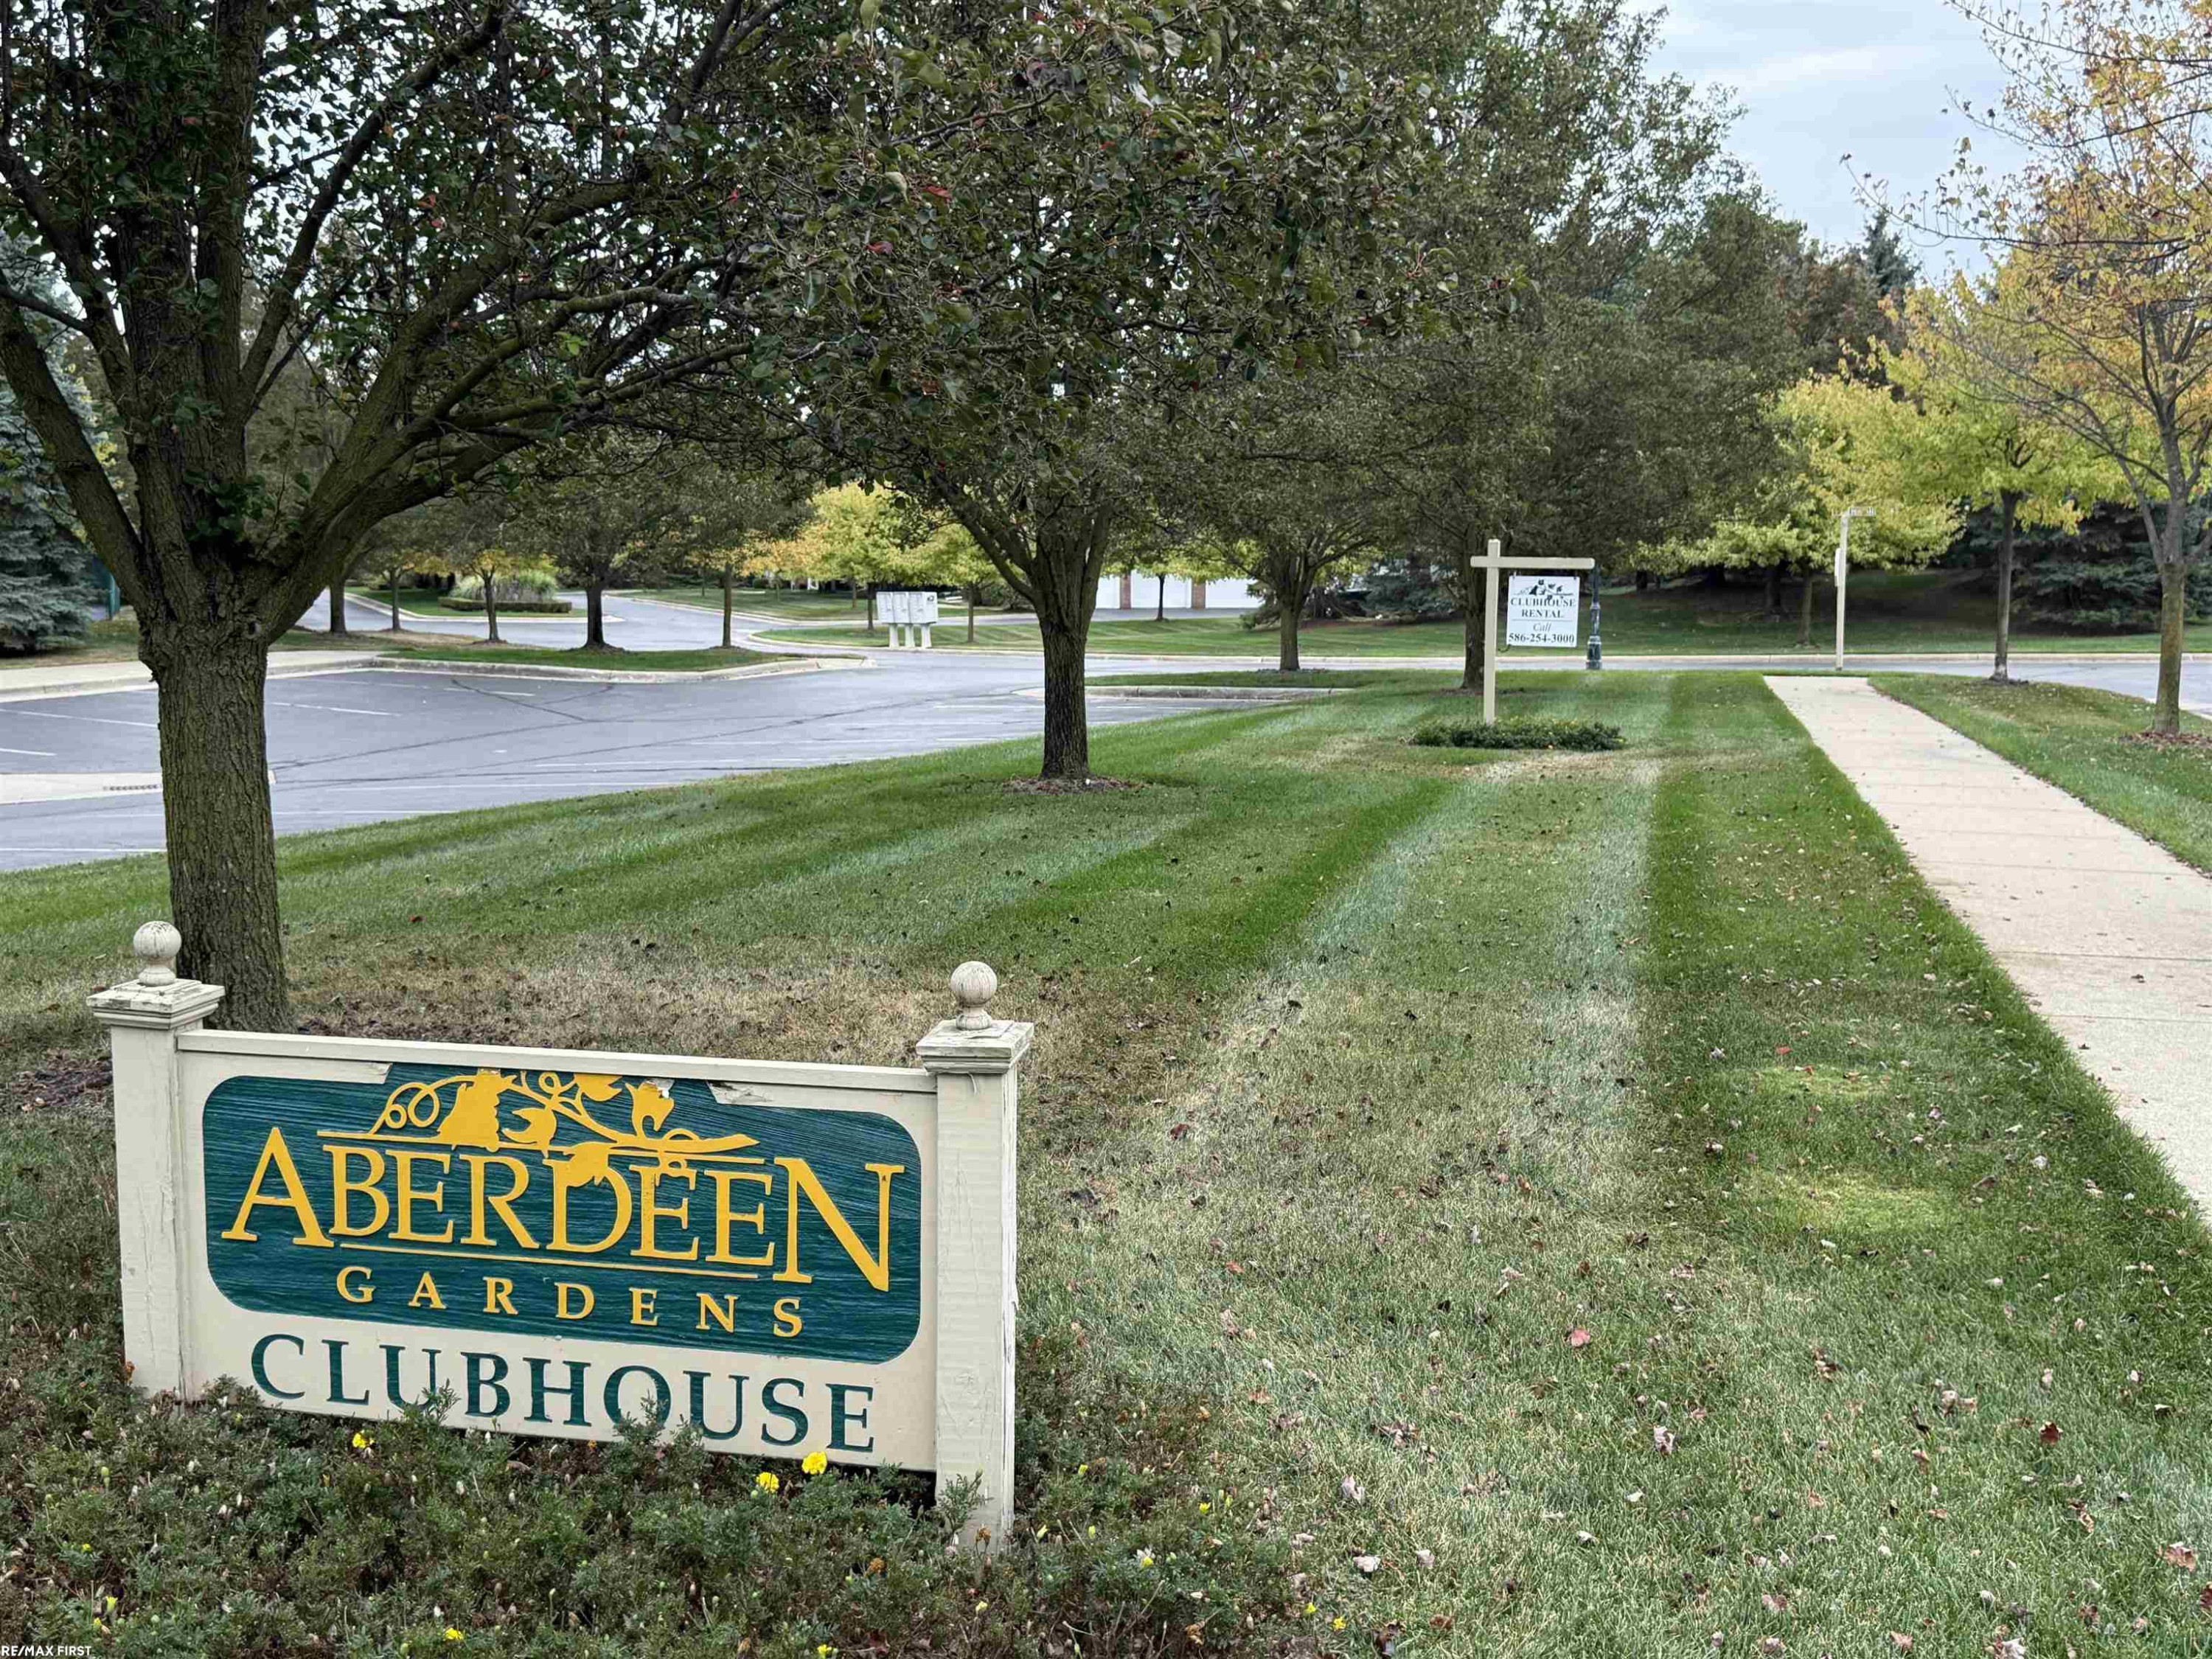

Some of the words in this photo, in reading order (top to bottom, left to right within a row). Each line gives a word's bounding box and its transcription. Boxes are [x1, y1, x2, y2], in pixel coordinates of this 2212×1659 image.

[1510, 597, 1576, 608] CLUBHOUSE
[1521, 609, 1564, 618] RENTAL
[1533, 622, 1551, 632] Call
[1509, 633, 1574, 643] 586-254-3000
[221, 1125, 905, 1293] ABERDEEN
[336, 1265, 803, 1338] GARDENS
[251, 1333, 875, 1453] CLUBHOUSE
